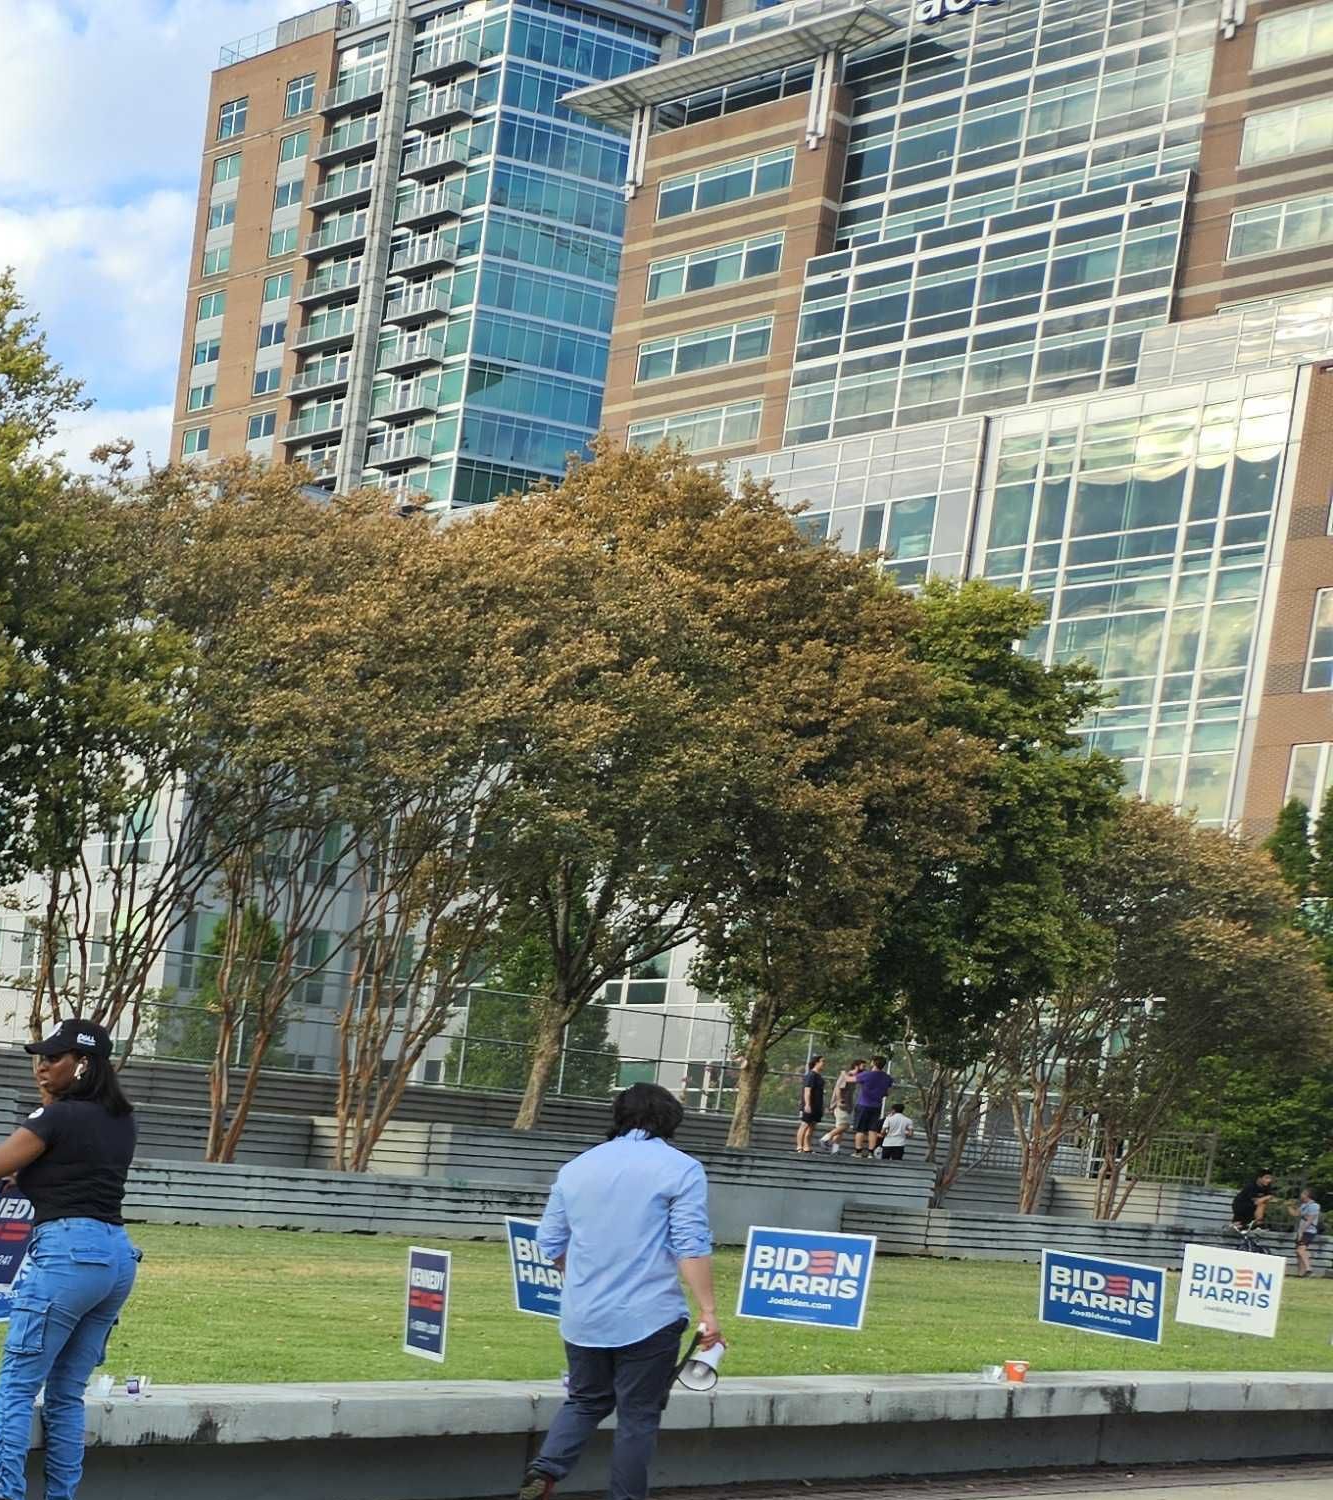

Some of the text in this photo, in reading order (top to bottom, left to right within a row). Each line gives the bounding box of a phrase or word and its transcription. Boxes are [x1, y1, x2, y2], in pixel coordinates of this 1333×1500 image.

[753, 1244, 863, 1278] BIDEN
[749, 1270, 859, 1299] HARRIS
[1050, 1265, 1156, 1301] BIDEN
[1191, 1263, 1272, 1291] BIDEN
[767, 1296, 832, 1311] JoeBiden.com
[1049, 1285, 1154, 1319] HARRIS
[1189, 1283, 1270, 1309] HARRIS
[1069, 1308, 1132, 1326] JoeBiden.com
